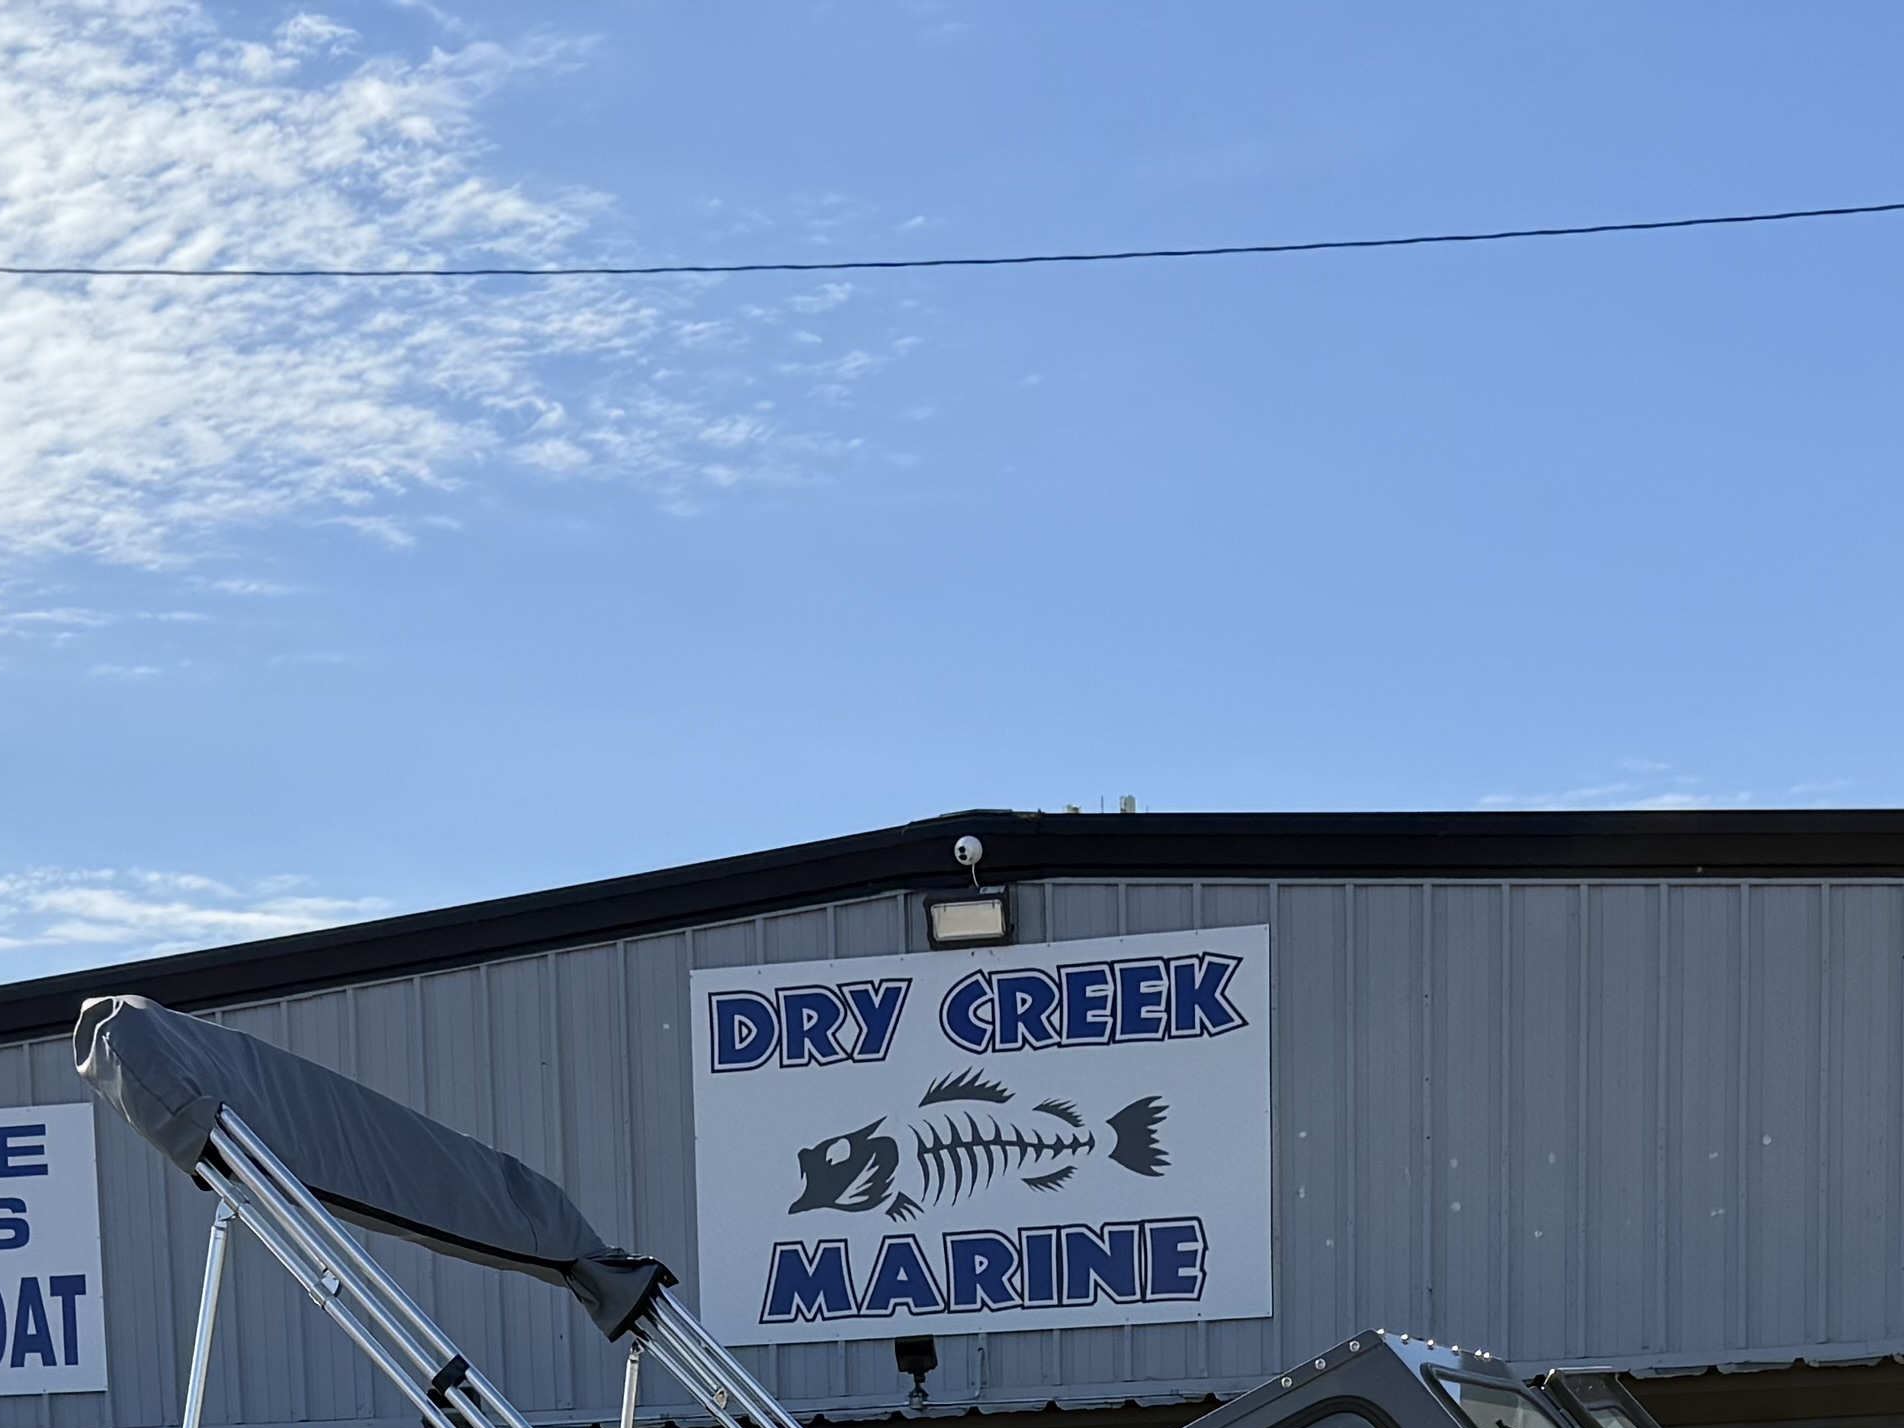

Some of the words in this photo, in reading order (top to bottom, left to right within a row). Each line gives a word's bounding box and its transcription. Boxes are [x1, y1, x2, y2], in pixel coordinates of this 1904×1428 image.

[708, 978, 913, 1073] DRY
[939, 952, 1249, 1054] CREEK
[759, 1217, 1209, 1324] MARINE
